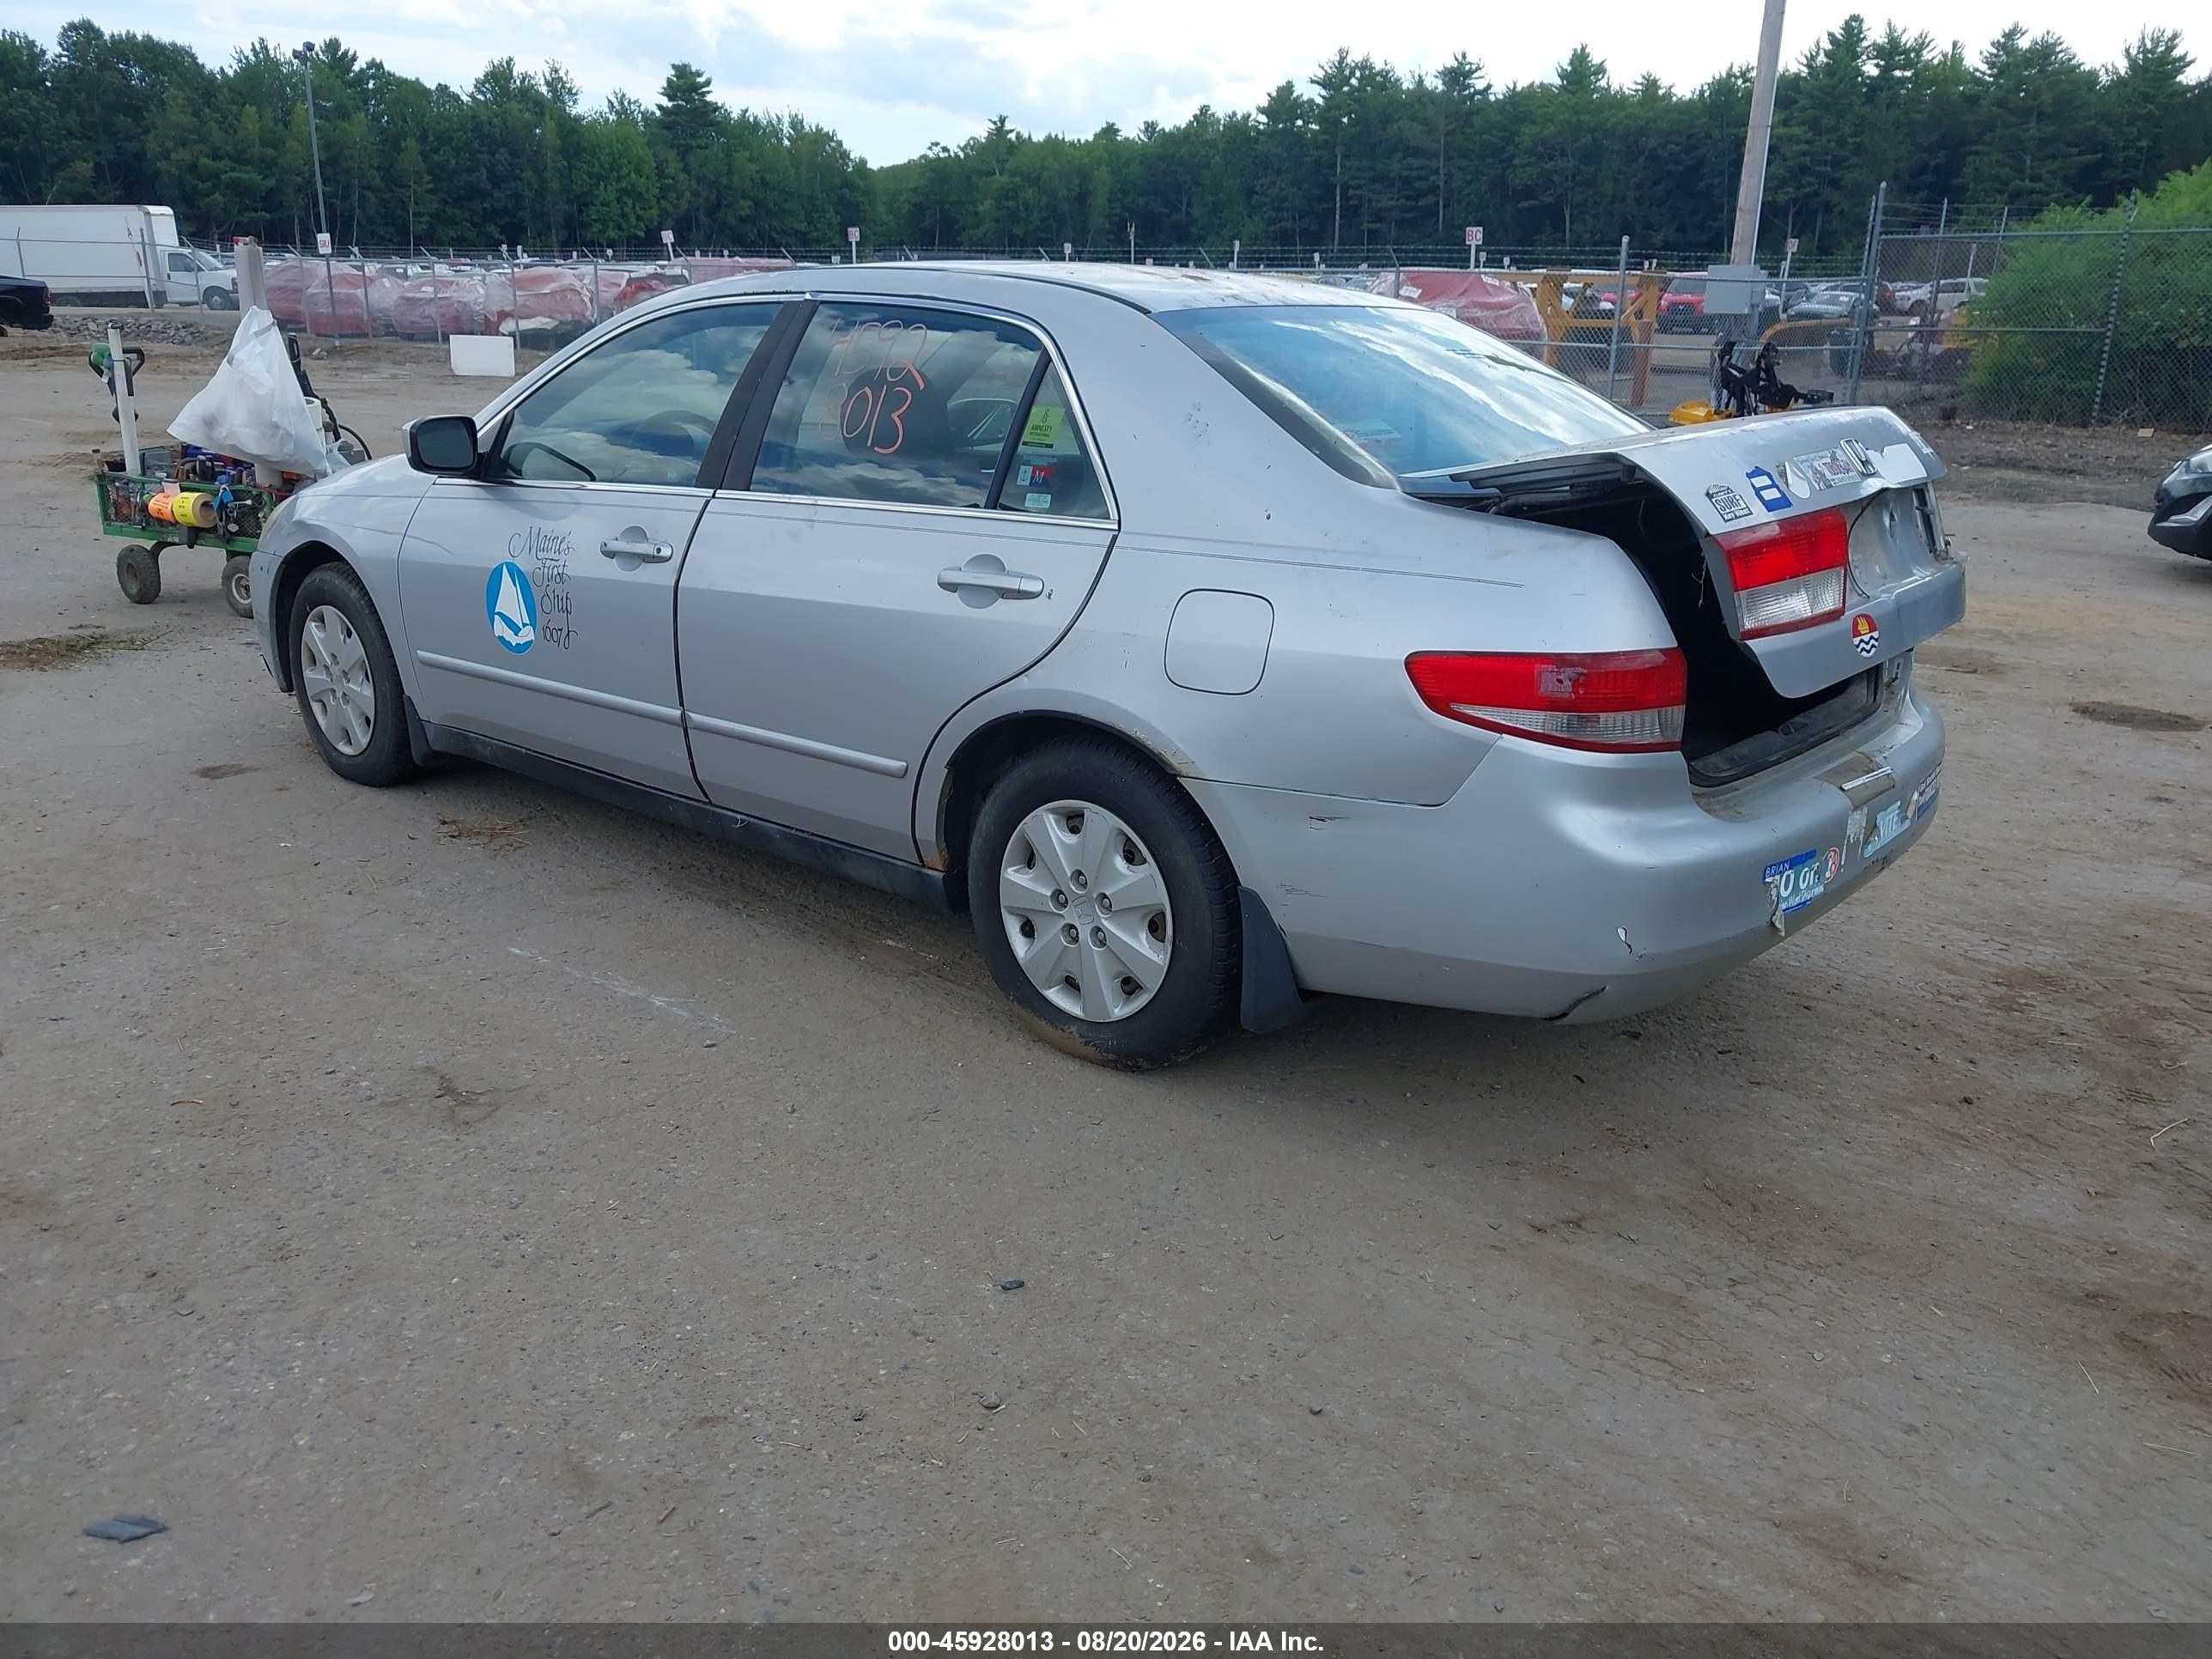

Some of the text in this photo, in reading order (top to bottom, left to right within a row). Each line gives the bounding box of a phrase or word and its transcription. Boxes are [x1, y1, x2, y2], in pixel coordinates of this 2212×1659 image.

[848, 229, 859, 240] BC
[1468, 229, 1481, 242] BC
[1714, 494, 1742, 513] SURF
[508, 526, 575, 561] Maine's
[532, 559, 571, 587] First
[542, 619, 564, 647] 1607
[1765, 860, 1790, 878] BRIAN
